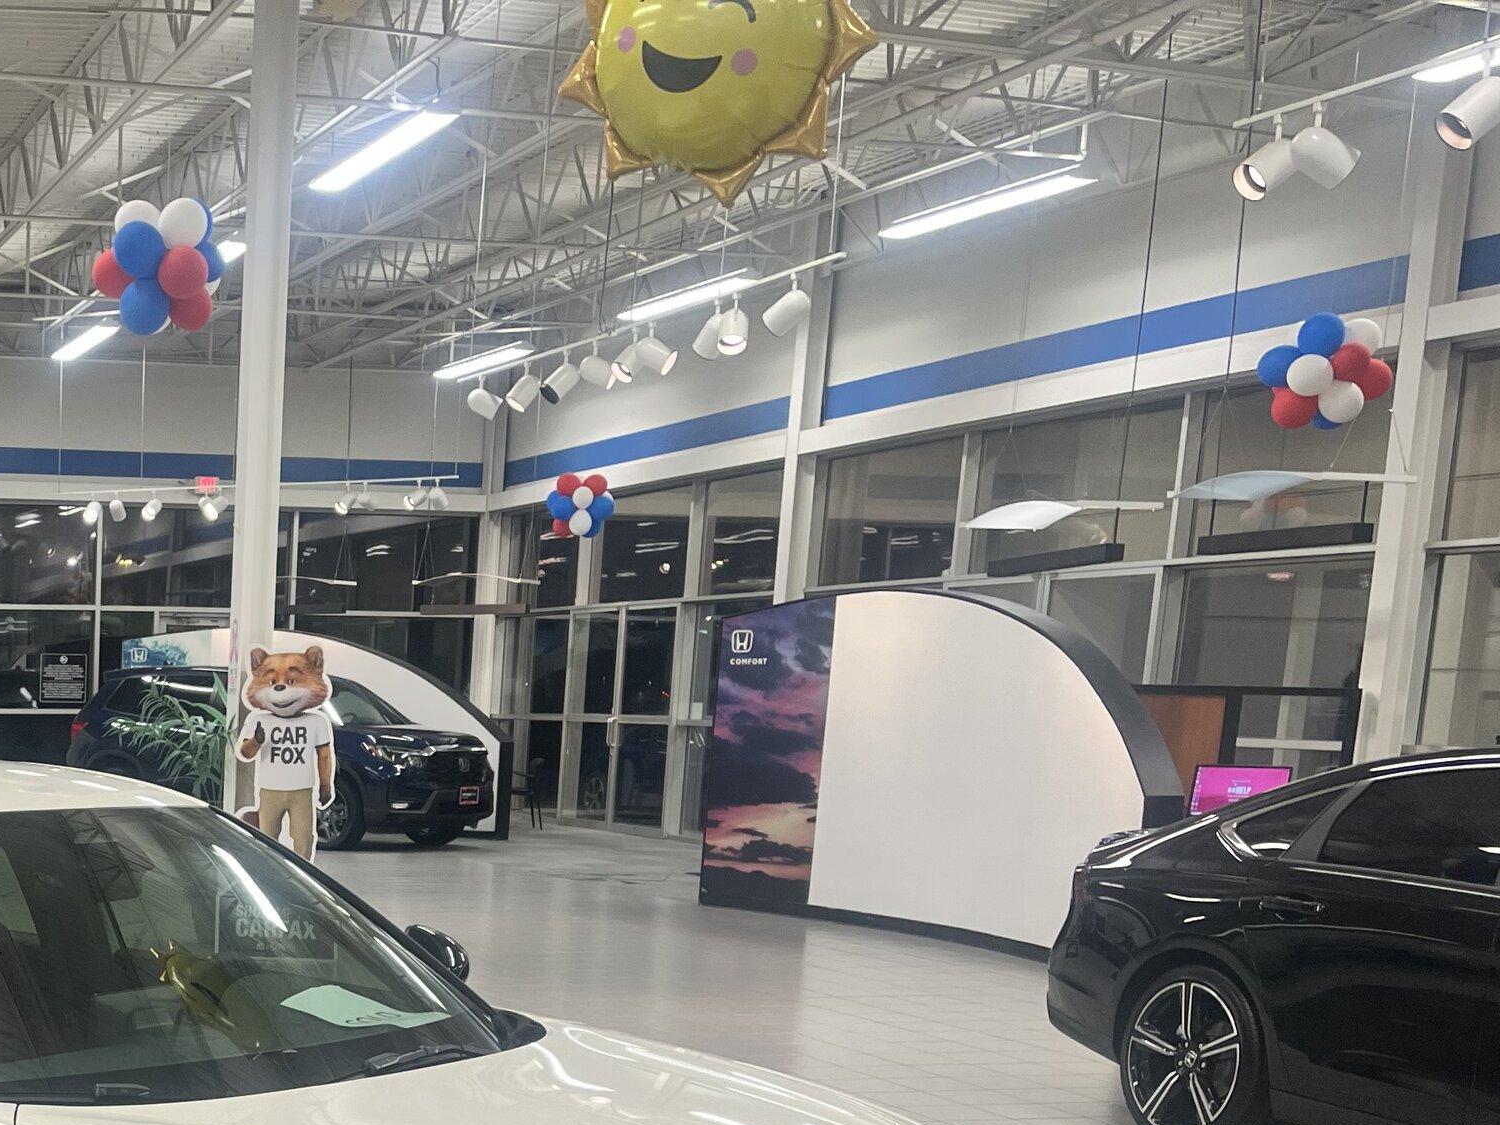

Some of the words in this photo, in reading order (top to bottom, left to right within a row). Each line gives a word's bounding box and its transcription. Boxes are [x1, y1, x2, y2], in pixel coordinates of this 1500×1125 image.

[729, 657, 768, 666] COMFORT
[270, 726, 307, 745] CAR
[270, 746, 306, 765] FOX
